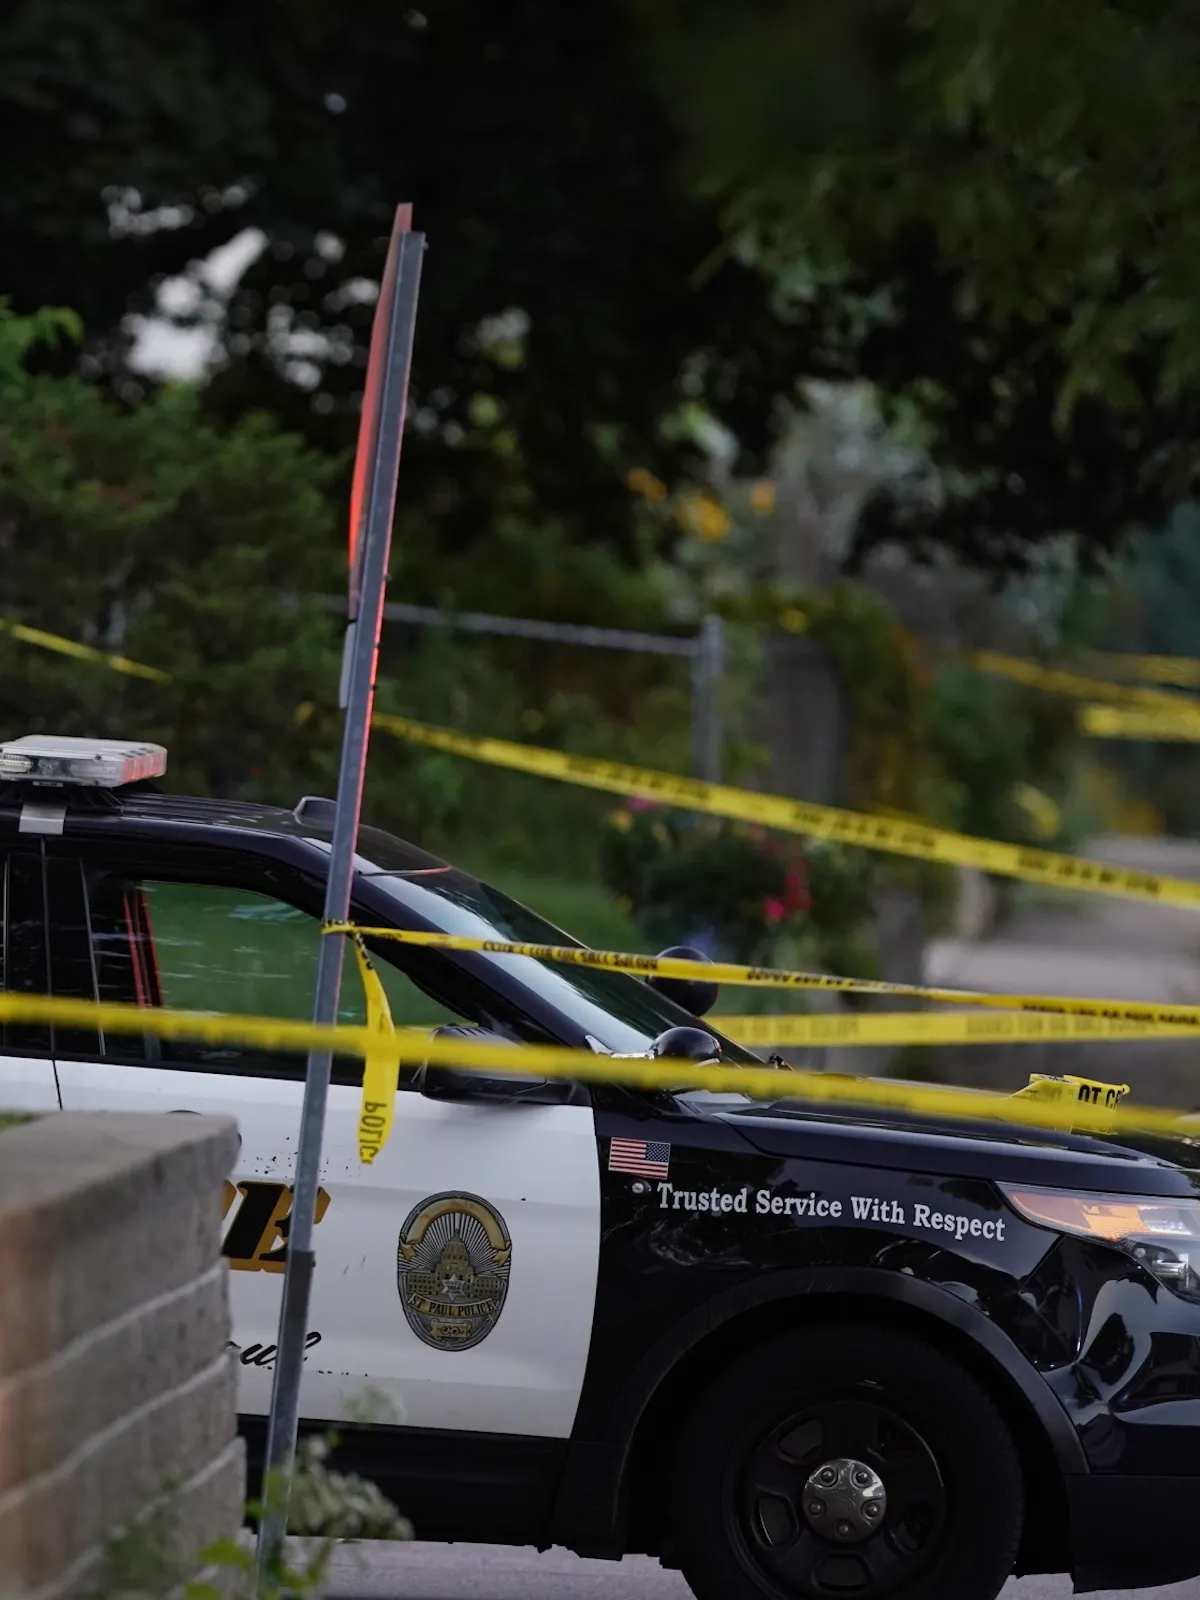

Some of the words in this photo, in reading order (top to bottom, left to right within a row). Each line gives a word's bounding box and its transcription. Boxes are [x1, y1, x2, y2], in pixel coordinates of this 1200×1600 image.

[1078, 1084, 1102, 1104] OT
[656, 1182, 748, 1214] Trusted
[755, 1189, 843, 1218] Service
[850, 1195, 906, 1225] With
[913, 1203, 1006, 1242] Respect
[410, 1295, 426, 1309] ST
[428, 1301, 455, 1317] PAUL
[457, 1300, 494, 1317] POLICE
